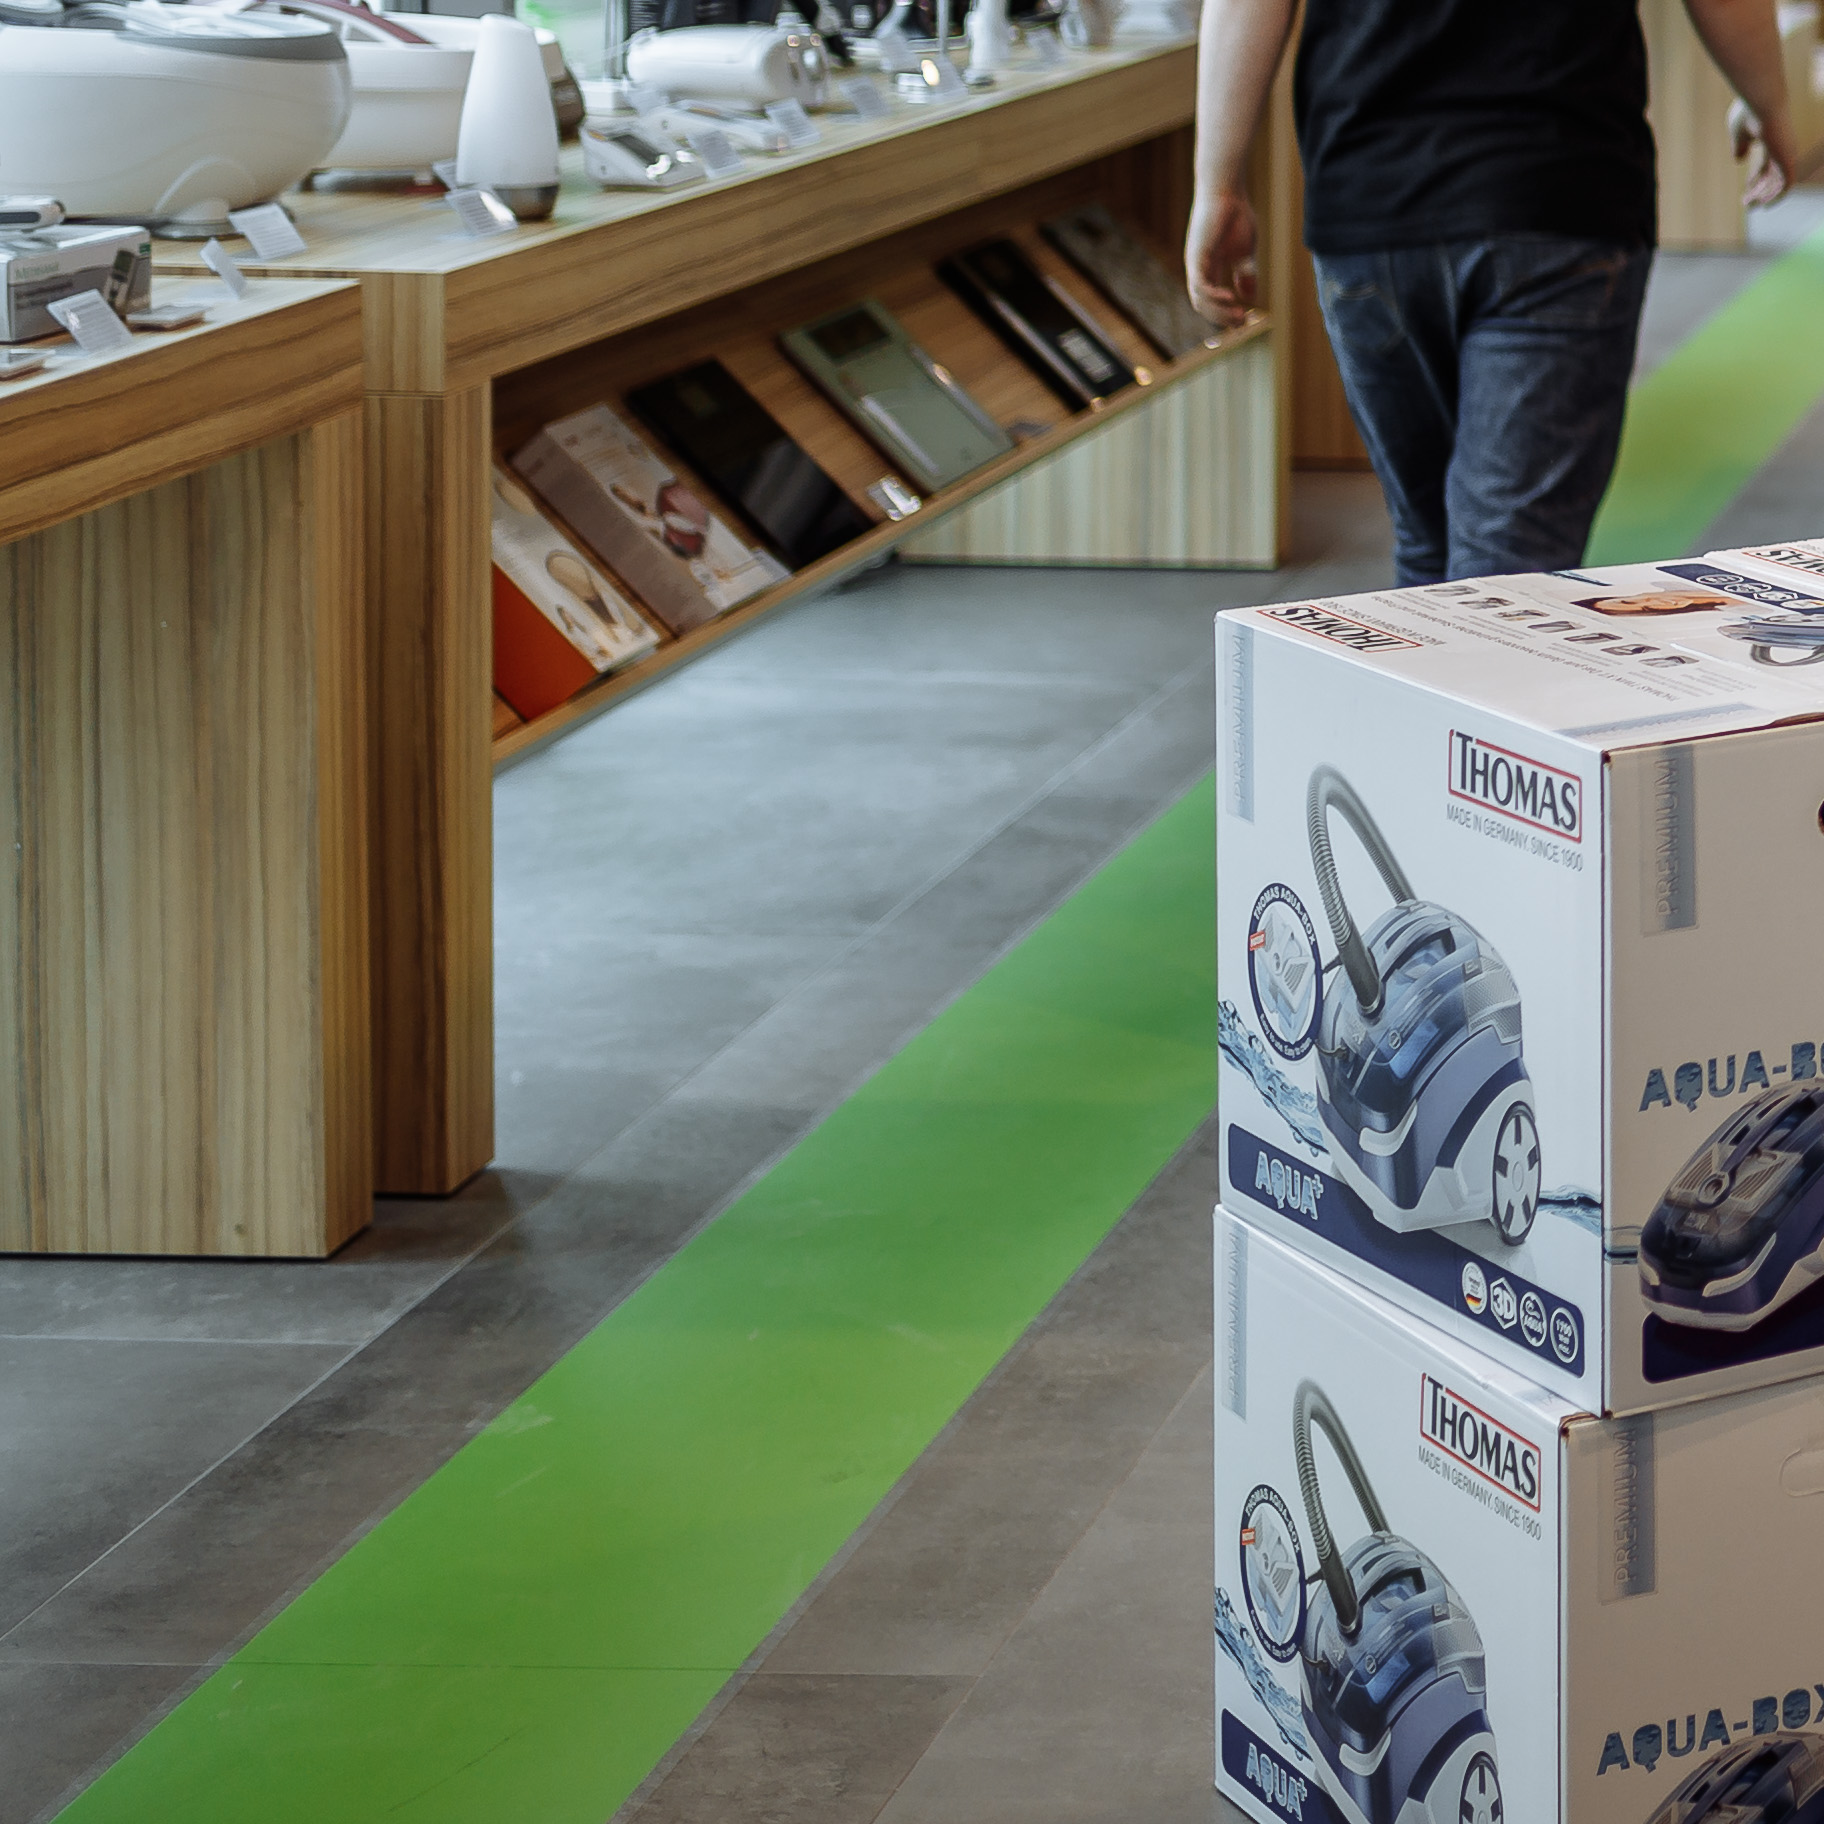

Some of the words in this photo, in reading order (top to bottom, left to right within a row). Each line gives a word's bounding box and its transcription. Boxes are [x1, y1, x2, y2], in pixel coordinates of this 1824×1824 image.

[1270, 606, 1404, 652] THOMAS
[1456, 730, 1577, 832] THOMAS
[1446, 803, 1472, 831] MADE
[1473, 814, 1482, 834] IN
[1529, 839, 1560, 862] SINCE
[1560, 850, 1584, 872] 1900
[1493, 1286, 1514, 1319] 3D
[1427, 1374, 1539, 1504] THOMAS
